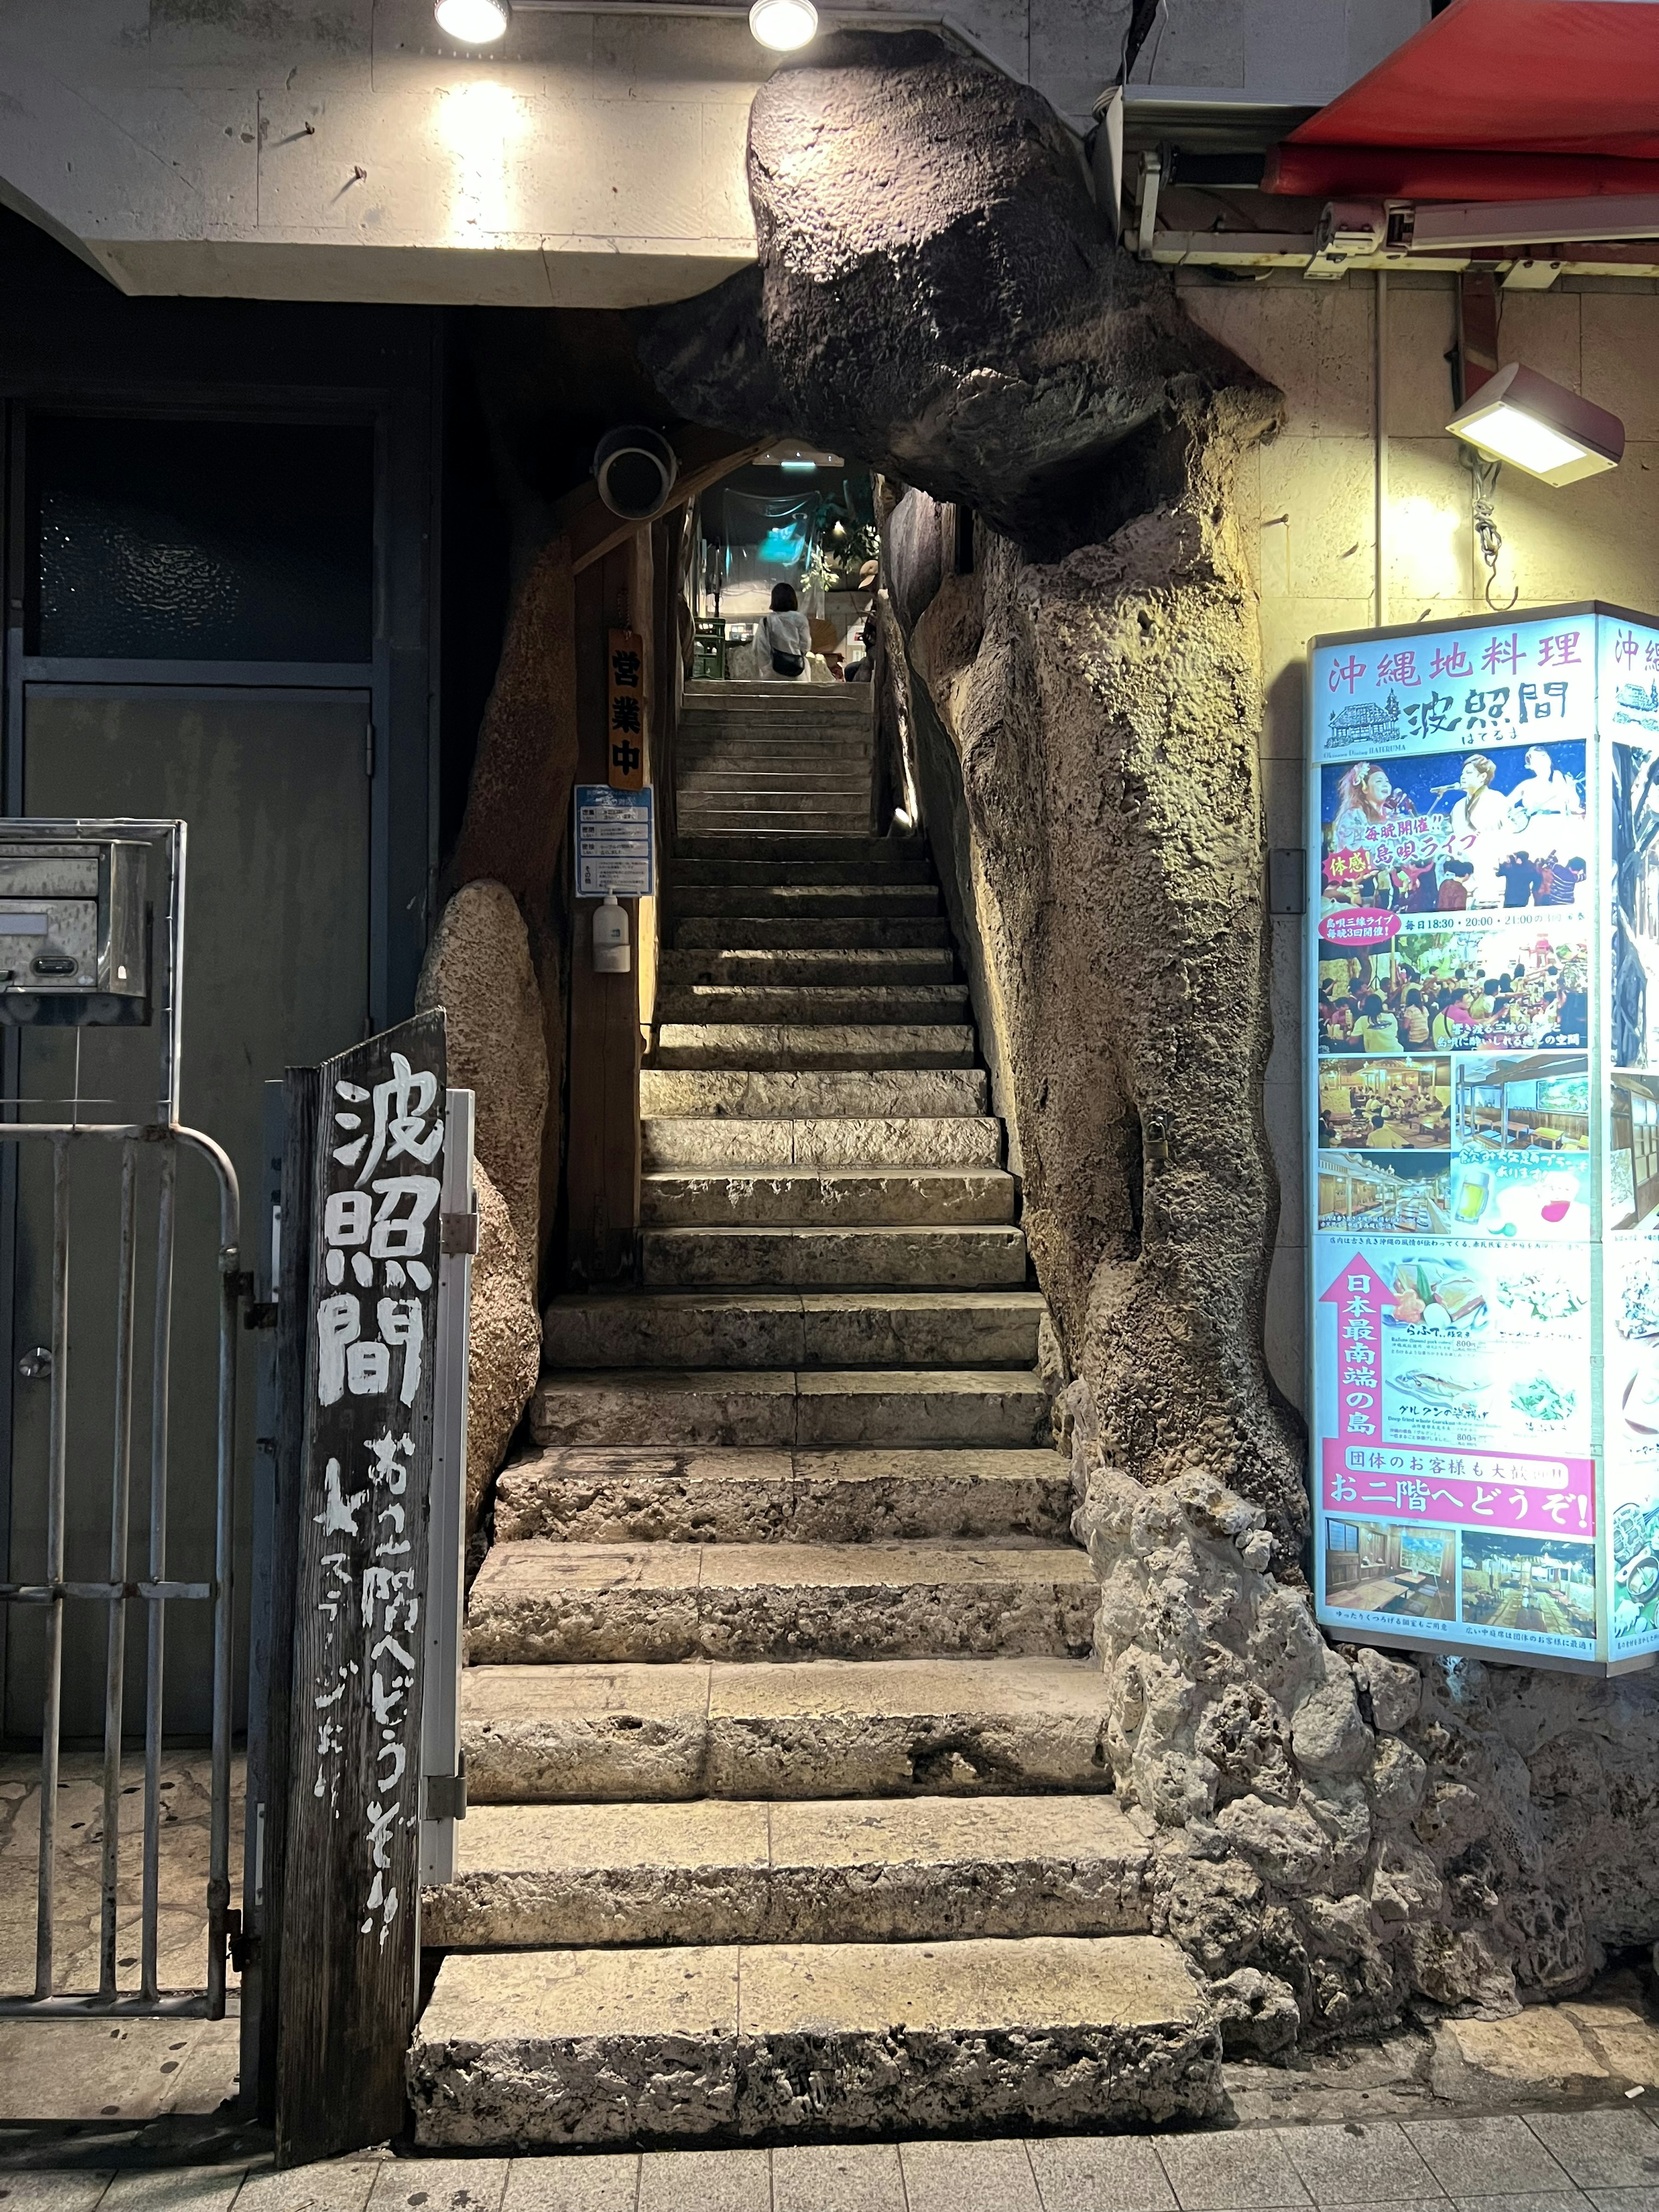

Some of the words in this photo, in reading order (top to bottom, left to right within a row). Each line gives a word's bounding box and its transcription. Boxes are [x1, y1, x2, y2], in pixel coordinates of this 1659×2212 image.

[1328, 632, 1581, 694] 沖縄地料理
[611, 649, 640, 776] 営業中
[1402, 681, 1569, 739] 波照間
[1461, 730, 1518, 745] はてるま
[1369, 744, 1406, 754] HATERUMA
[1330, 852, 1372, 876] 体感!
[1375, 831, 1481, 864] 島唄ライブ
[317, 1052, 445, 1408] 波照間
[1342, 1274, 1378, 1436] 日本最南端の島
[1330, 1472, 1588, 1529] お二階へどうぞ!
